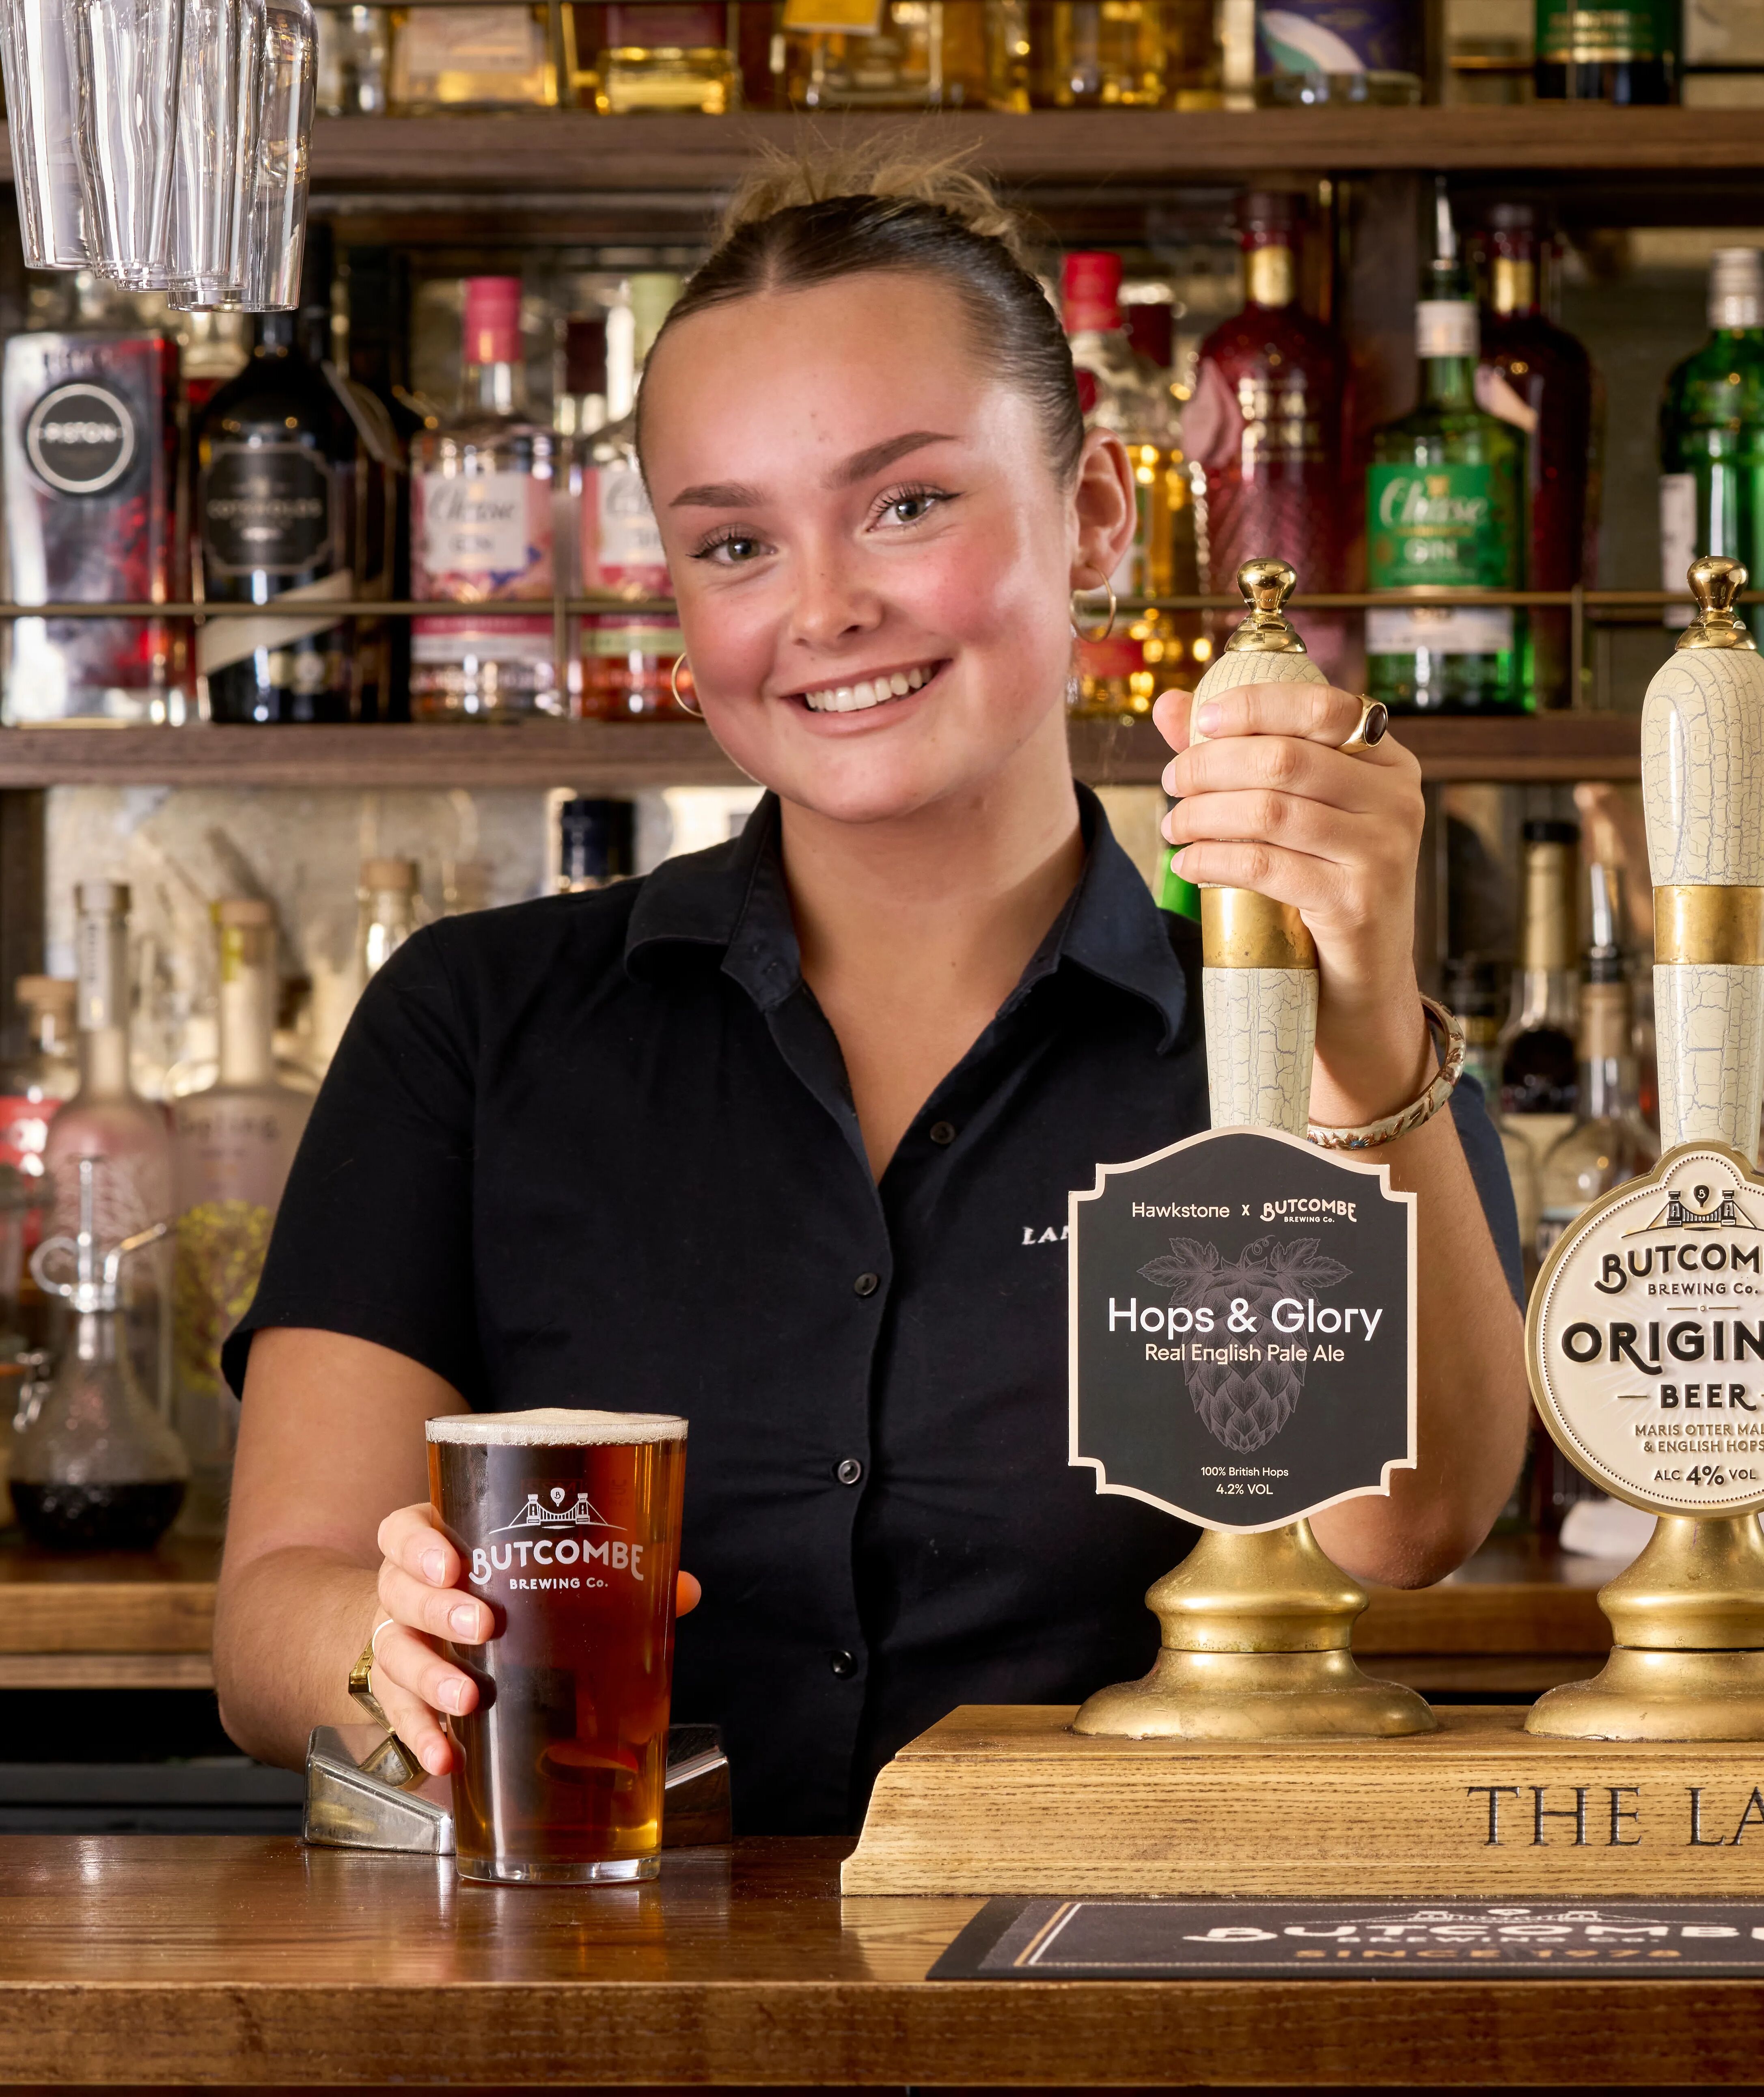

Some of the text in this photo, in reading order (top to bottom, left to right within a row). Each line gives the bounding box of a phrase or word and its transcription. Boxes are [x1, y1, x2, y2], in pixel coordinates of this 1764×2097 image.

[1132, 1202, 1230, 1218] Hawkstone
[1260, 1198, 1357, 1222] BUTCOMBE
[1648, 1282, 1758, 1295] BREWING Co.
[1109, 1297, 1383, 1341] Hops & Glory
[1145, 1343, 1345, 1365] Real English Pale Ale
[1661, 1384, 1757, 1411] BEER
[1635, 1424, 1682, 1437] MARIS
[1685, 1424, 1734, 1436] OTTER
[1643, 1440, 1764, 1453] & ENGLISH HOPS
[1201, 1466, 1289, 1478] 100% British Hops
[1654, 1465, 1756, 1485] ALC 4% VOL
[1216, 1483, 1274, 1495] 4.2% VOL
[469, 1539, 644, 1585] BUTCOMBE
[509, 1577, 608, 1590] BREWING Co.
[1467, 1786, 1642, 1847] THE
[1183, 1925, 1764, 1942] BUTCOMB
[1295, 1949, 1501, 1958] SINCE
